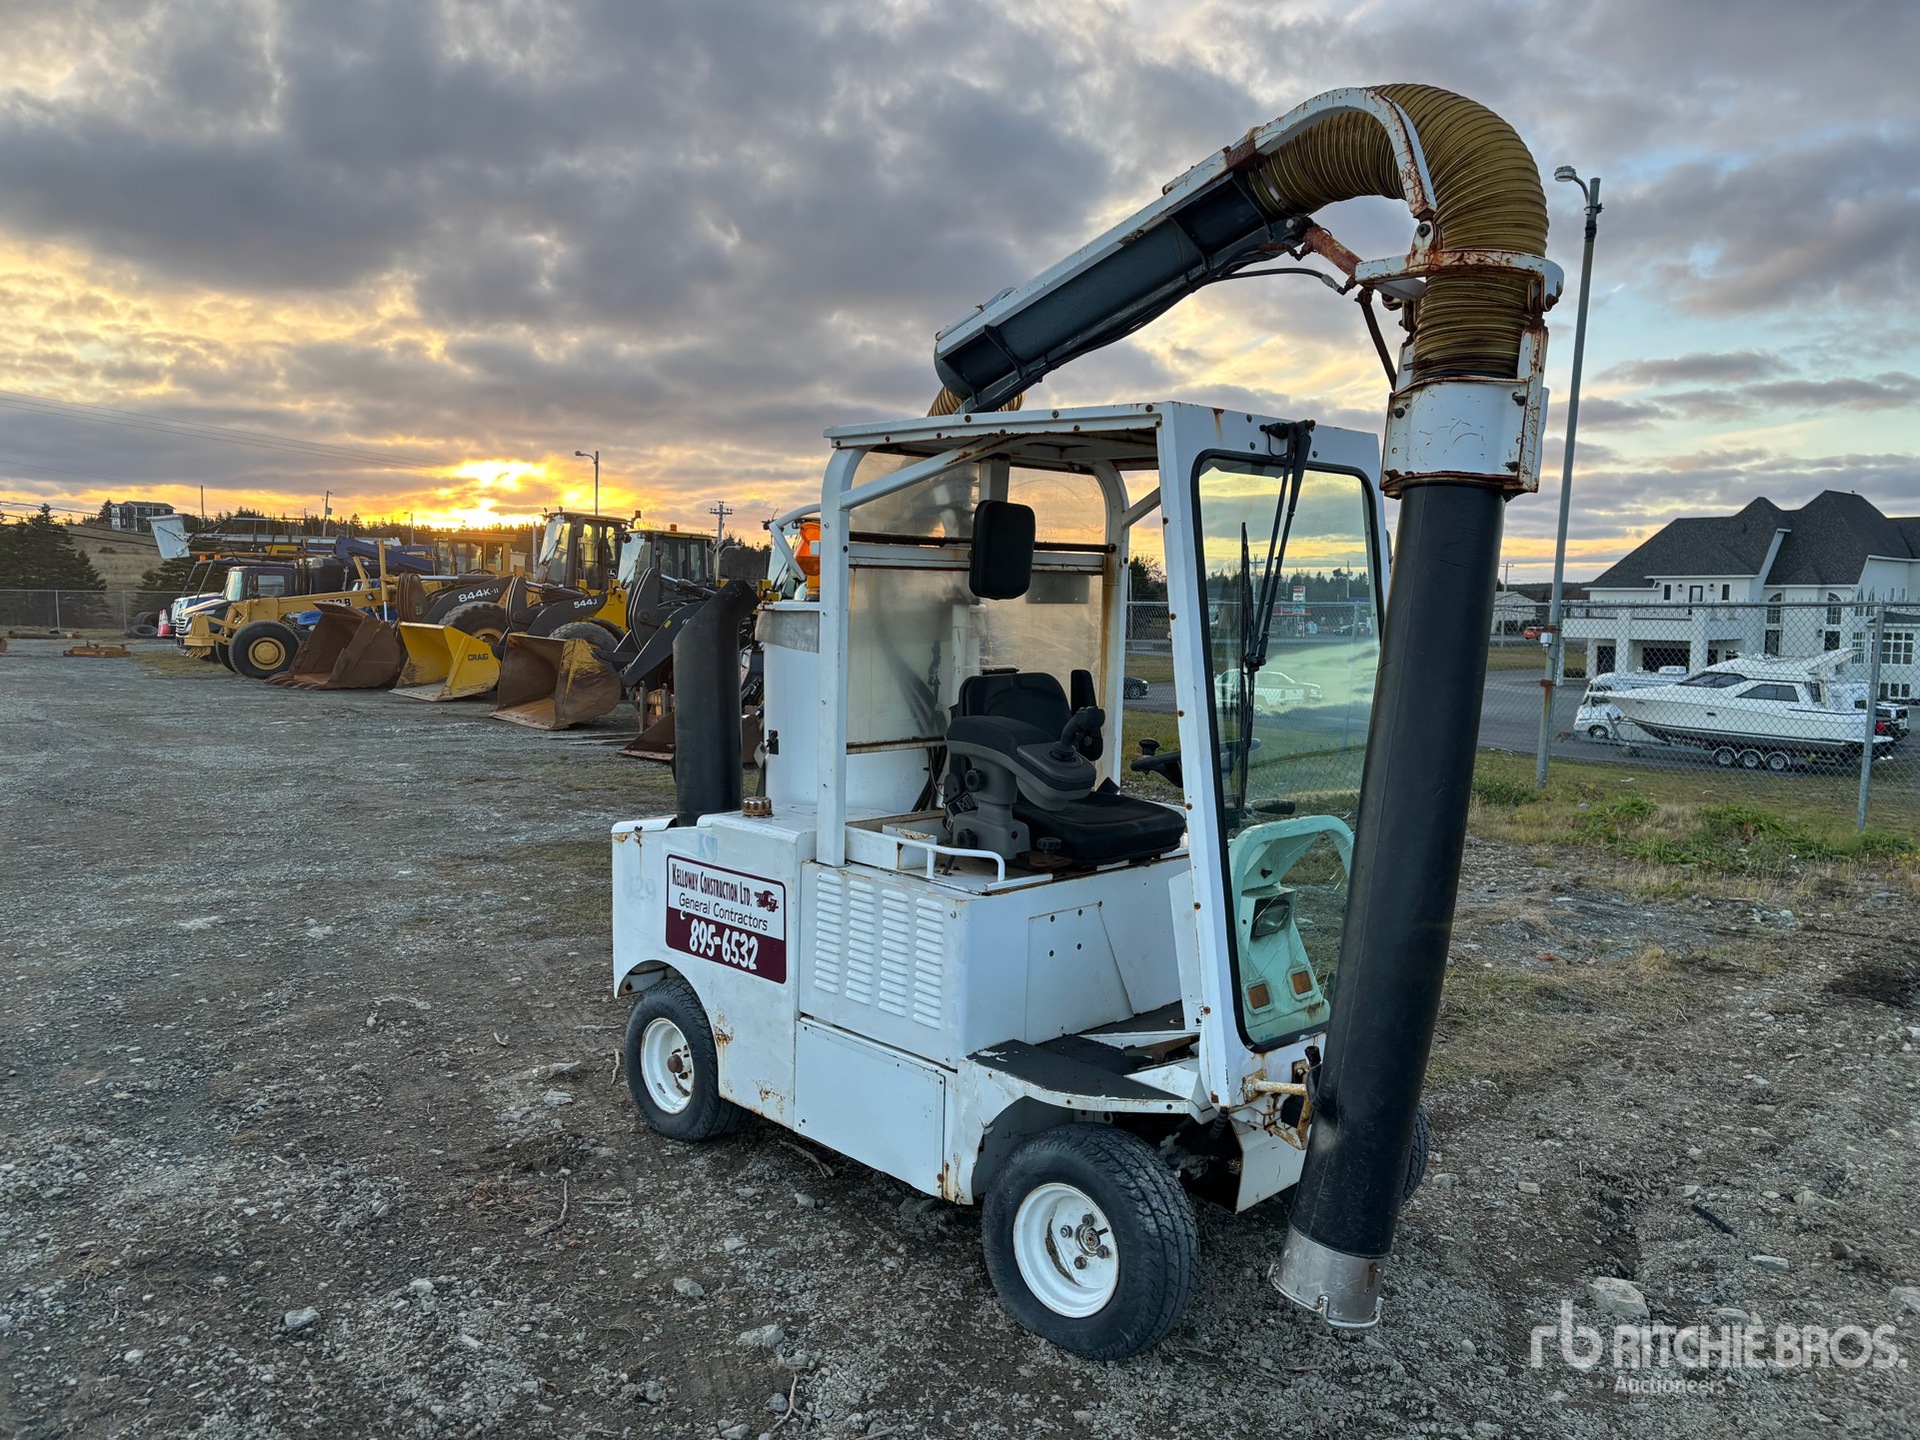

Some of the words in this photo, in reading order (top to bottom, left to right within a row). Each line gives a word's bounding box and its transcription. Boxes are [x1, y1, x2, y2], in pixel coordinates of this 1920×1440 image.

[573, 598, 598, 609] 544J
[467, 653, 489, 662] CRAIG
[679, 892, 711, 915] General
[713, 902, 768, 931] Contractors
[689, 918, 759, 970] 895-6532
